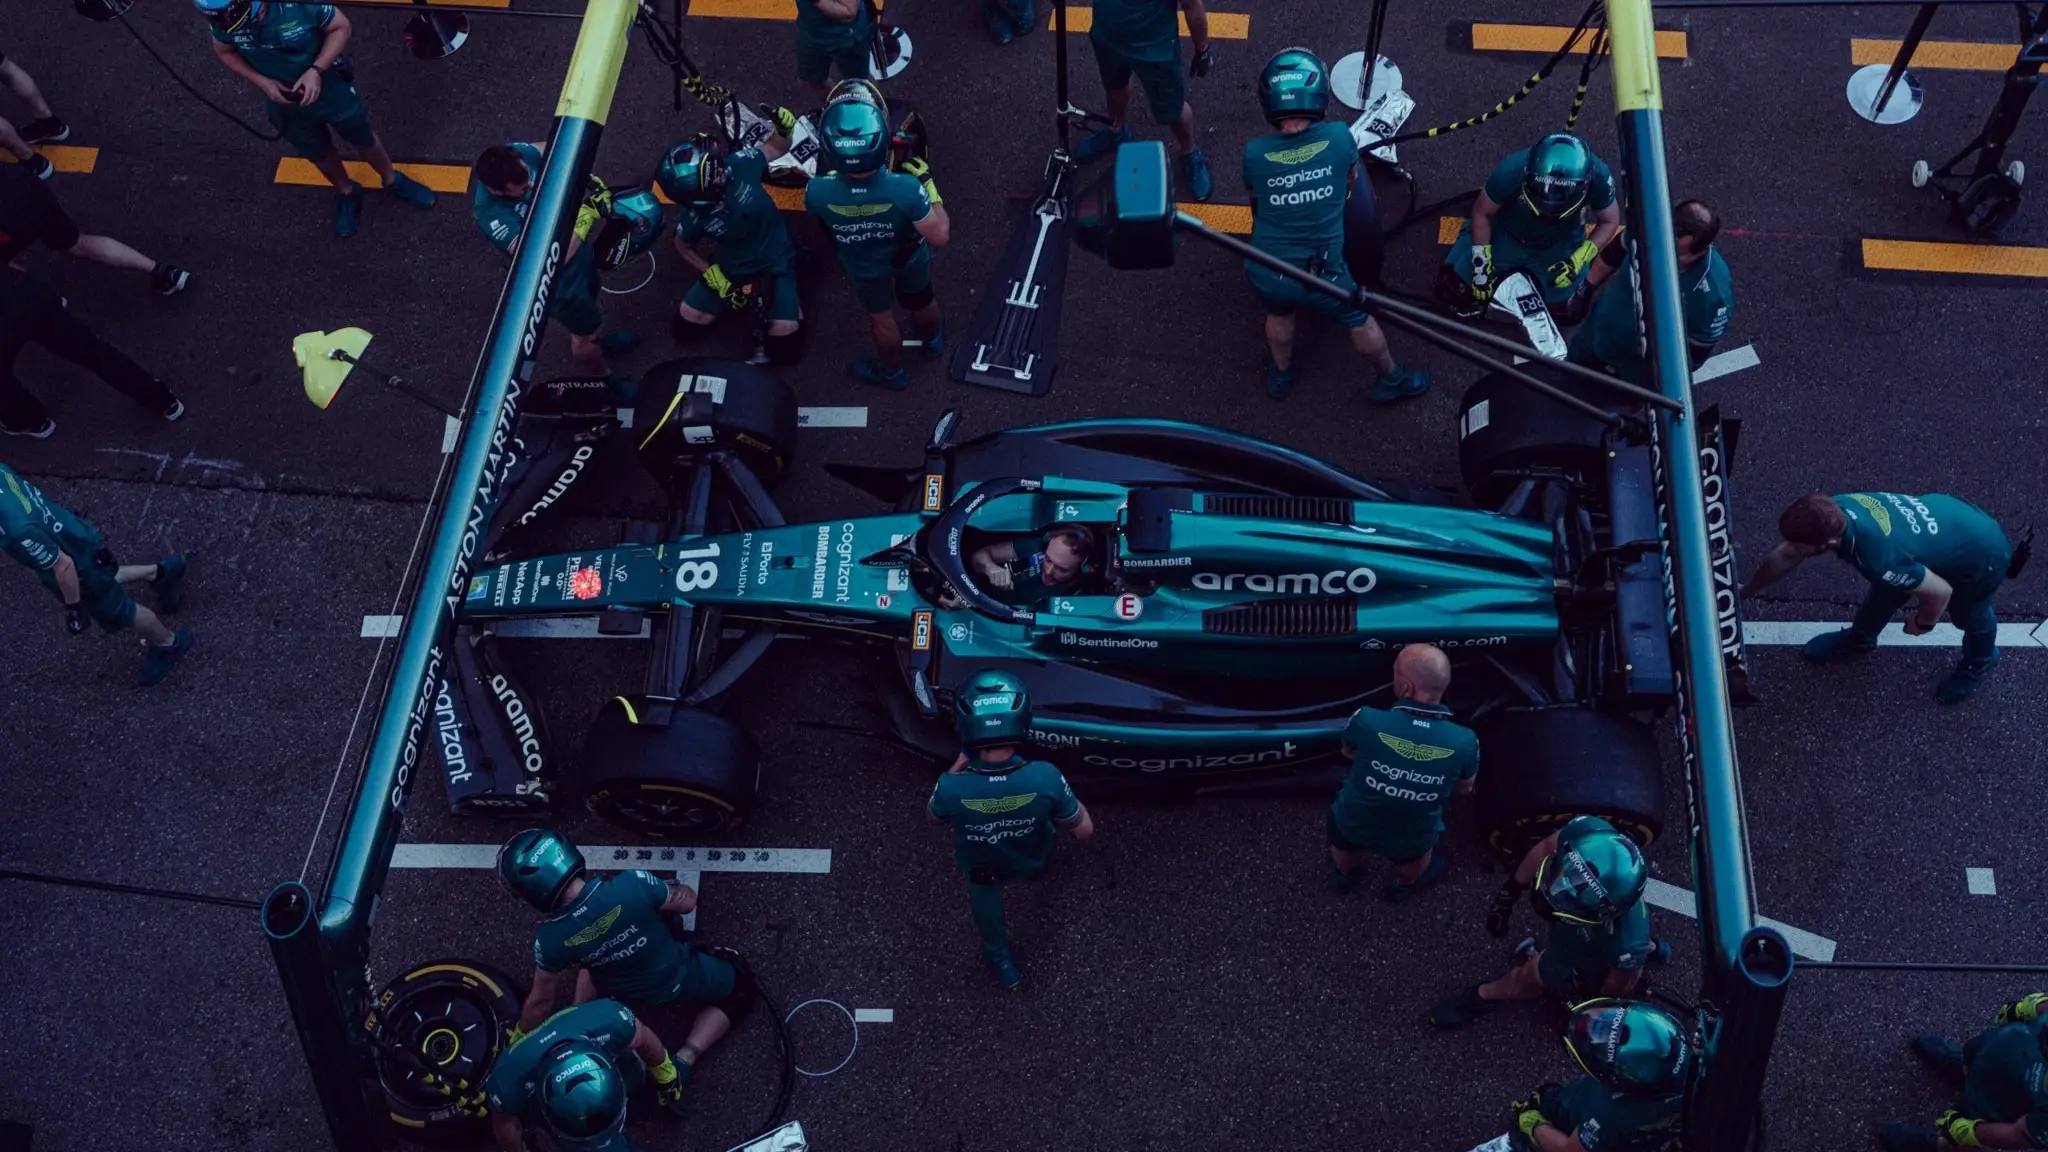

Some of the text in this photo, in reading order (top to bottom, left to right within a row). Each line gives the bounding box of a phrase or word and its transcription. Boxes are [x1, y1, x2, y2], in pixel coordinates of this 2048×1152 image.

[1271, 72, 1304, 83] aramco
[744, 121, 767, 146] RF2
[834, 138, 867, 148] aramco
[793, 135, 820, 163] RF1
[1267, 165, 1333, 189] cognizant
[1269, 184, 1334, 206] aramco
[832, 221, 894, 233] cognizant
[524, 240, 561, 356] aramco
[1519, 295, 1546, 316] RR1
[547, 381, 609, 389] AVATRADE
[447, 504, 485, 619] ASTON
[478, 379, 521, 504] MARTIN
[927, 477, 940, 507] JCB
[965, 493, 985, 514] aramco
[675, 541, 721, 593] 18
[736, 532, 753, 597] FLY SAUDIA
[757, 552, 772, 586] Porto
[811, 525, 831, 599] BOMBARDIER
[835, 522, 855, 603] cognizant
[1123, 556, 1193, 568] BOMBARDIER
[511, 561, 529, 606] NetApp
[565, 556, 582, 600] PERONI
[960, 573, 981, 597] aramco
[1190, 567, 1378, 595] aramco
[878, 596, 889, 607] N
[1121, 597, 1136, 616] E
[916, 615, 928, 647] JCB
[1078, 636, 1159, 649] SentinelOne
[973, 695, 1009, 708] aramco
[391, 646, 444, 808] cognizant
[491, 674, 543, 772] aramco
[1026, 728, 1081, 747] ERONI
[1082, 740, 1297, 773] cognizant
[1371, 759, 1446, 786] cognizant
[1365, 775, 1439, 802] aramco
[964, 817, 1037, 834] cognizant
[530, 837, 556, 864] aramco
[1568, 851, 1605, 899] ASTON MARTIN
[1607, 1006, 1625, 1063] ASTON MARTIN
[555, 1059, 592, 1083] aramco
